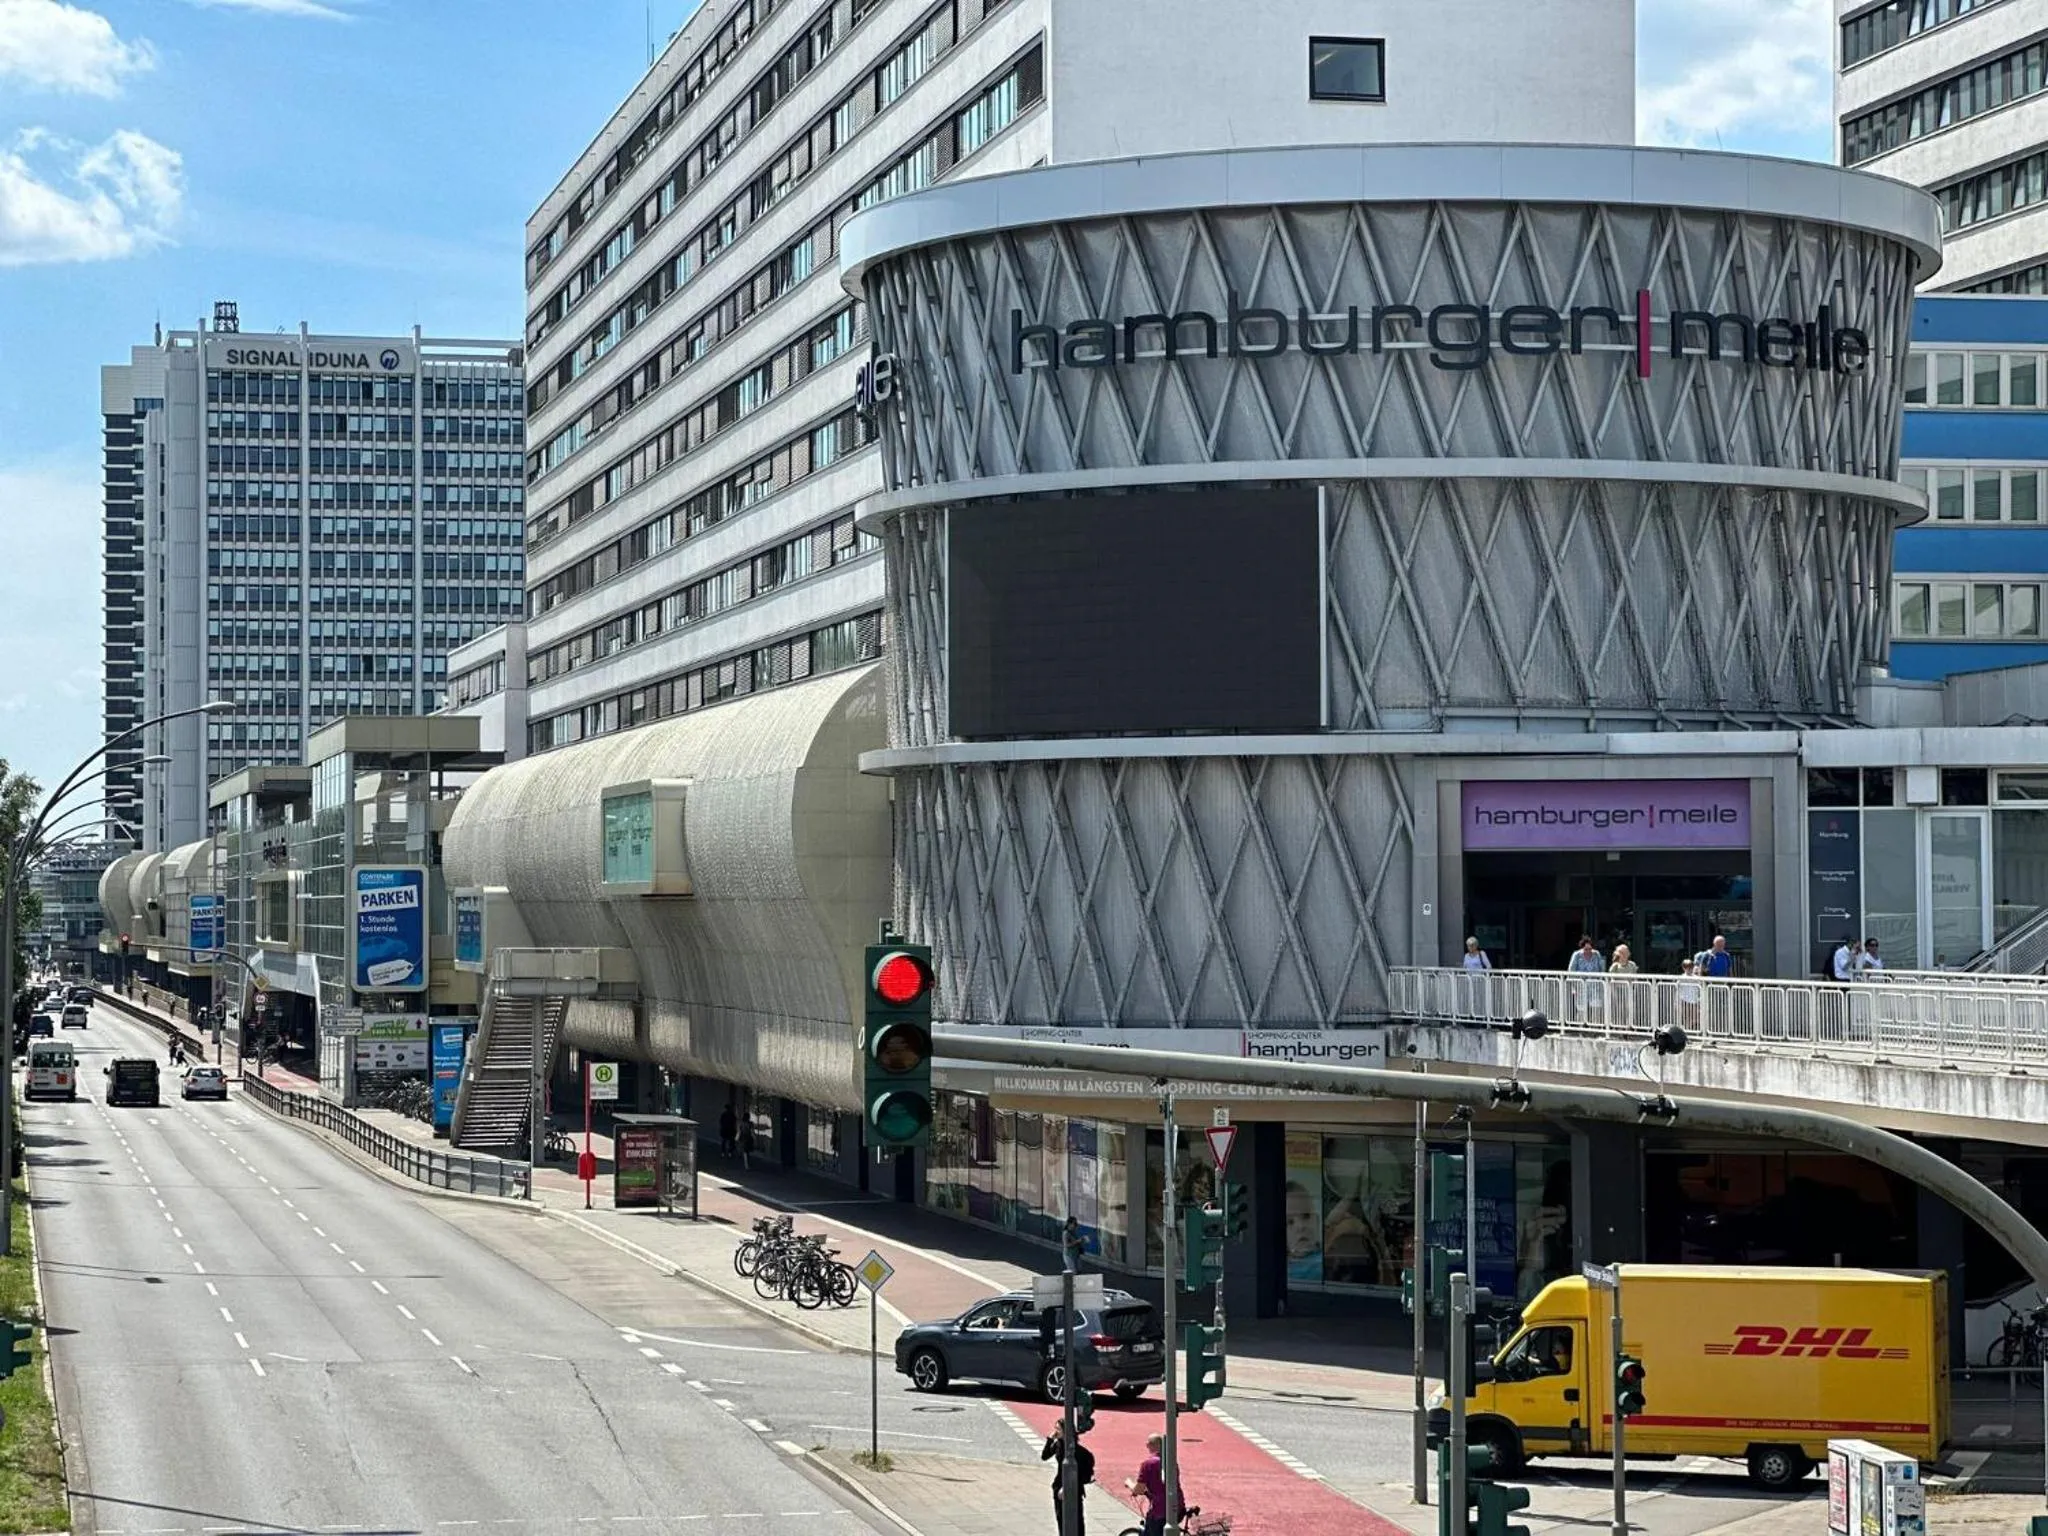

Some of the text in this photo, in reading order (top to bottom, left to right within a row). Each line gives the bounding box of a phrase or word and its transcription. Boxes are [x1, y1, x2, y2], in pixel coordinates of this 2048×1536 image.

[1011, 288, 1870, 377] hamburger meile
[226, 348, 370, 369] SIGNAL IDUNA
[1474, 804, 1738, 828] hamburger meile
[361, 889, 415, 908] PARKEN
[368, 914, 396, 923] Stunde
[359, 924, 398, 933] kostenlos
[1247, 1031, 1322, 1040] SHOPPING-CENTER
[1247, 1041, 1380, 1060] hamburger
[994, 1076, 1060, 1091] WILLKOMMEN
[1063, 1078, 1078, 1092] IM
[1079, 1077, 1144, 1094] LÄNGSTEN
[1731, 1325, 1883, 1359] DHL
